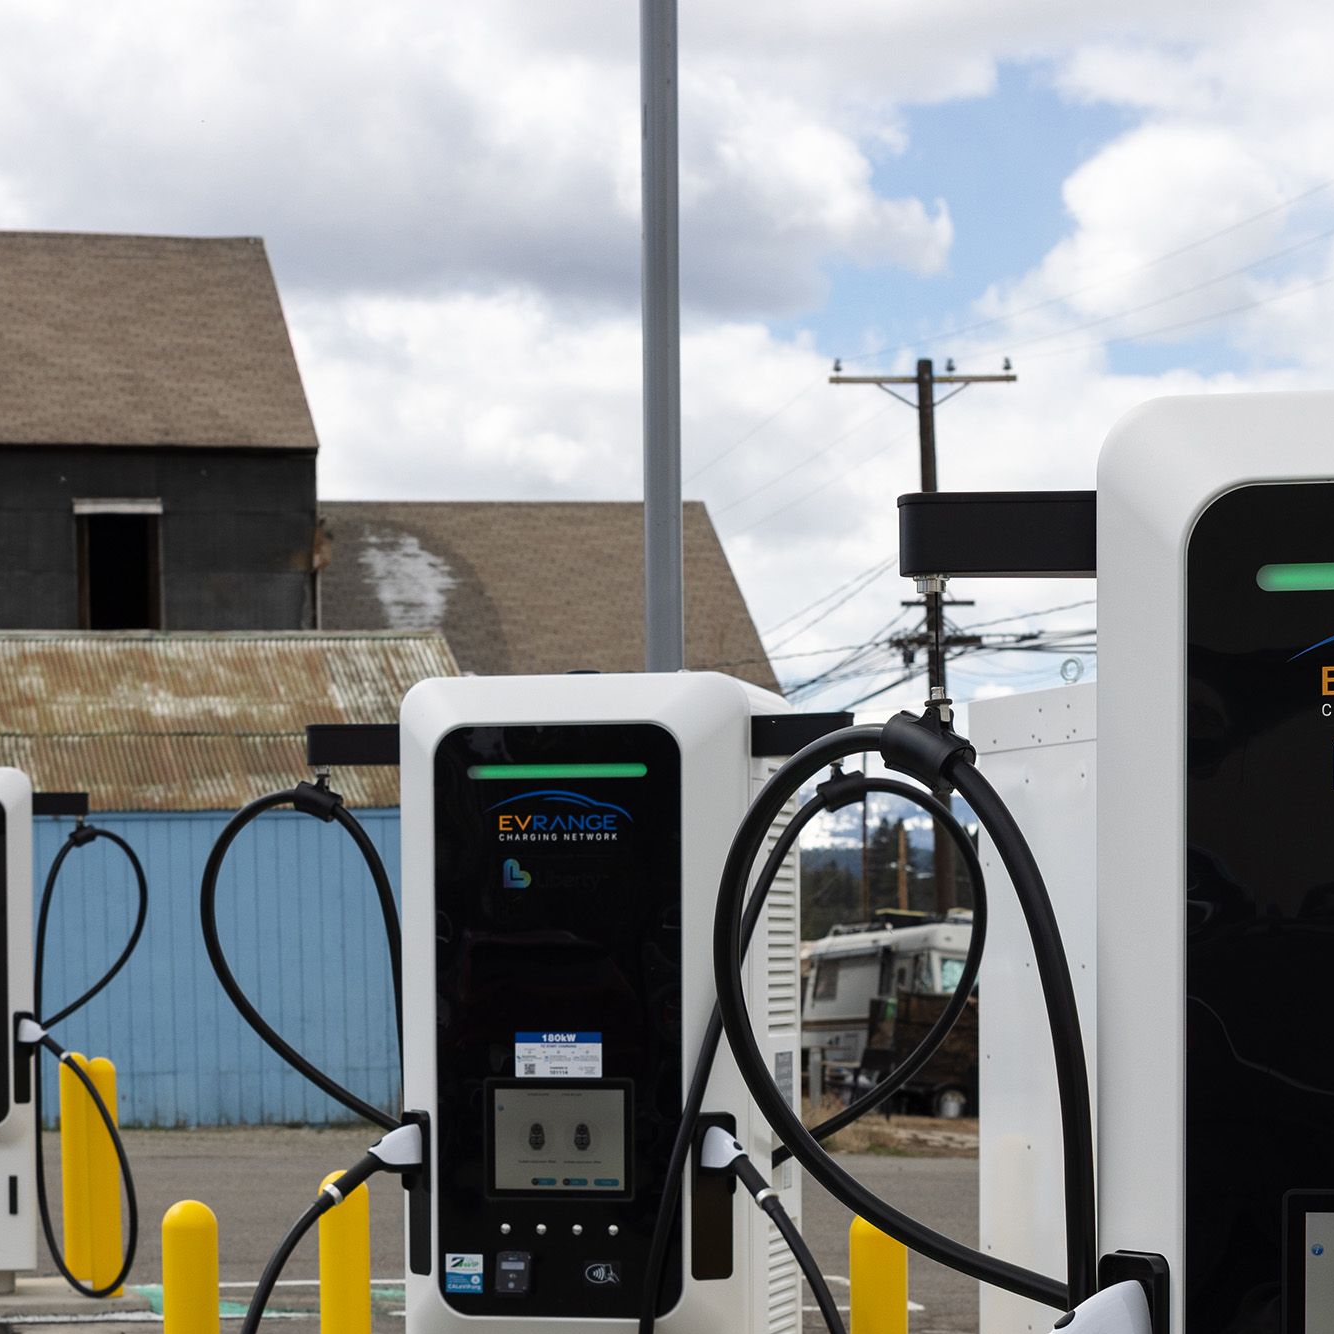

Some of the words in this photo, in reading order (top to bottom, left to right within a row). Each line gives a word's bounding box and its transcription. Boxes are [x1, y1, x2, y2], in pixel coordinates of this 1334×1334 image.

[499, 814, 618, 831] EVRANGE
[498, 832, 559, 841] CHARGING
[564, 831, 618, 841] NETWORK
[541, 1033, 577, 1042] 180kW
